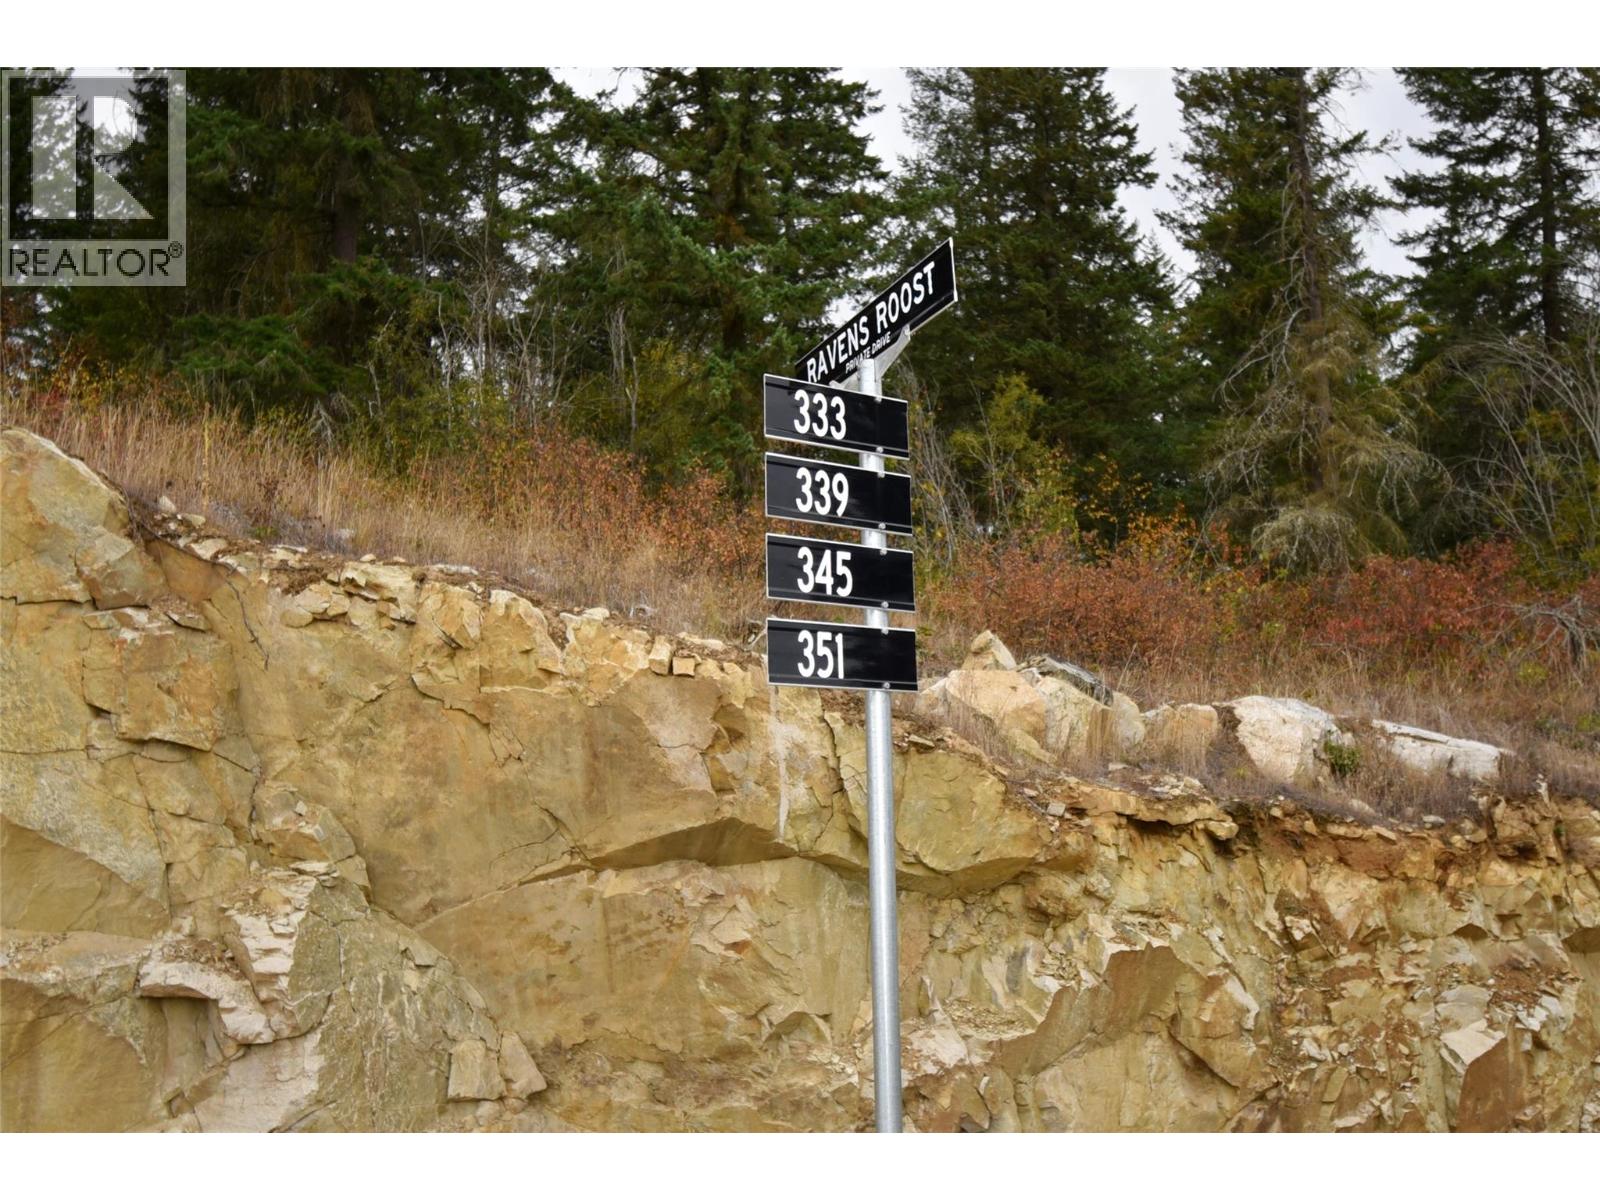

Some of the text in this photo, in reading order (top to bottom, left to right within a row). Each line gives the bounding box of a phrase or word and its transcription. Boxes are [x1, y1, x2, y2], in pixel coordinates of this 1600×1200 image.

[806, 261, 936, 383] RAVENS ROOST
[845, 331, 892, 374] PRIVATE DRIVE
[793, 389, 847, 440] 333
[795, 467, 849, 517] 339
[797, 546, 853, 597] 345
[797, 630, 845, 680] 351
